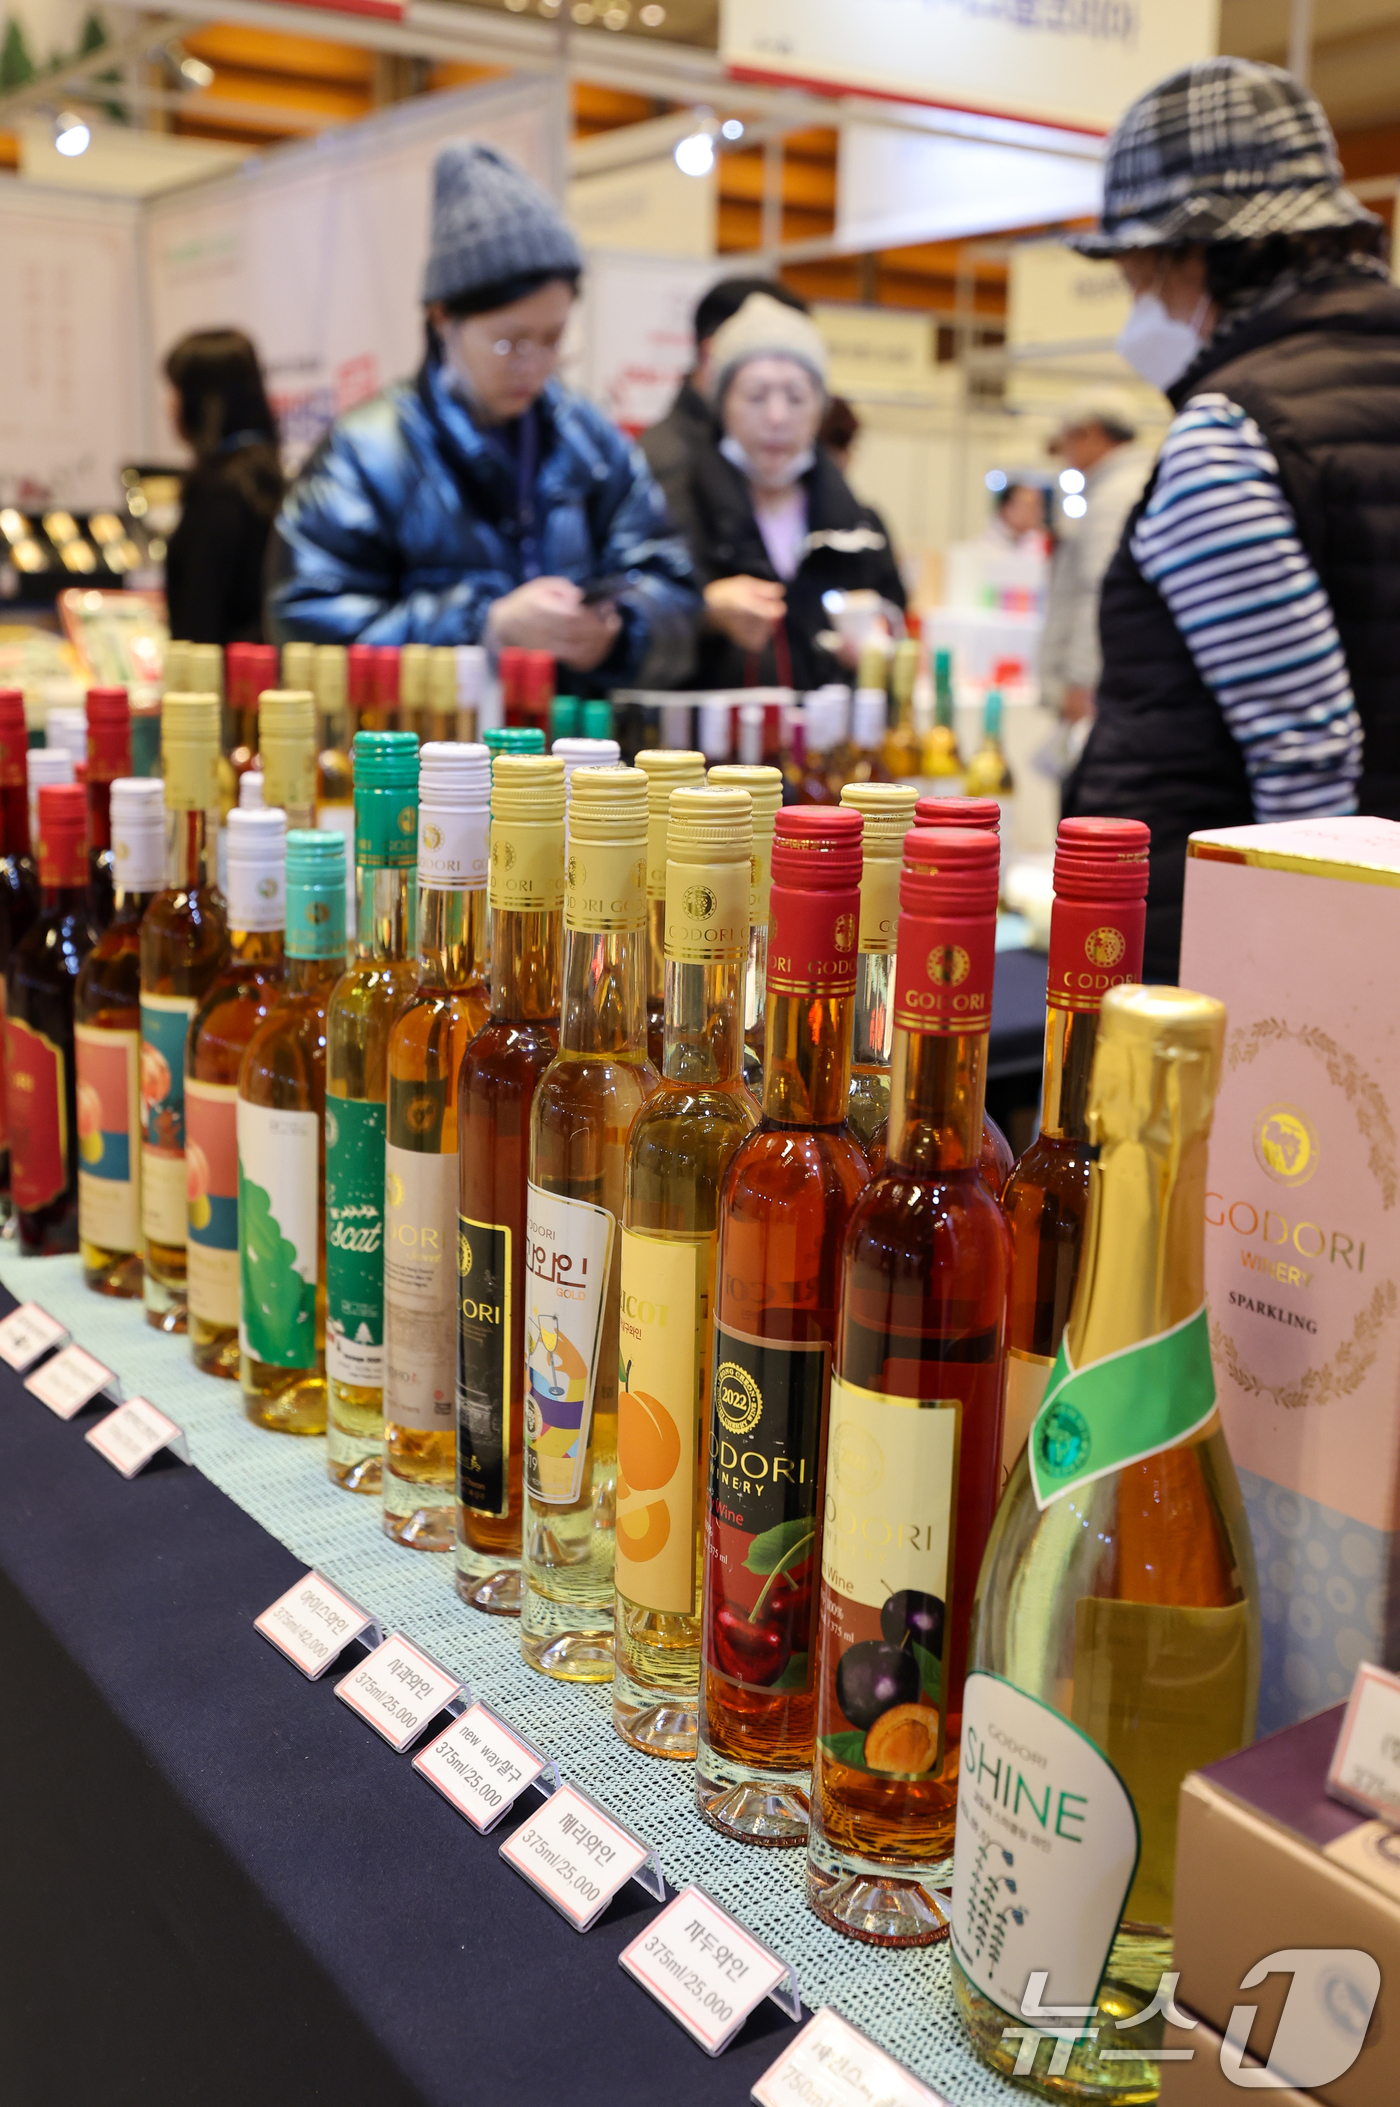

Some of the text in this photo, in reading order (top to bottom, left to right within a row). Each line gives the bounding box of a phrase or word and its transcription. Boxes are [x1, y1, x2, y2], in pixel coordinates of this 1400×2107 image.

[419, 857, 461, 873] ODORI
[807, 960, 856, 976] GODO
[330, 1221, 383, 1253] scat
[1205, 1191, 1366, 1274] GODORI
[1240, 1249, 1315, 1289] WINERY
[459, 1296, 500, 1325] ORI
[556, 1287, 586, 1301] GOLD
[620, 1290, 669, 1329] ICOT
[1228, 1290, 1318, 1335] SPARKLING
[721, 1386, 748, 1411] 2022
[707, 1430, 805, 1484] ODORI
[715, 1498, 744, 1526] Wine
[825, 1493, 932, 1552] ODORI
[827, 1566, 854, 1594] Wine
[300, 1590, 350, 1636] 아이스와인
[830, 1620, 855, 1644] 375 ml
[355, 1671, 418, 1729] 375ml/25,000
[387, 1658, 435, 1701] 사과와인
[435, 1741, 503, 1807] 375ml/25,000
[458, 1725, 523, 1783] new way살구
[965, 1725, 1089, 1843] SHINE
[558, 1812, 617, 1868] 체리와인
[522, 1829, 601, 1902] 375ml/25,000
[684, 1919, 750, 1984] 자두와인
[644, 1936, 734, 2023] 375ml/25,000
